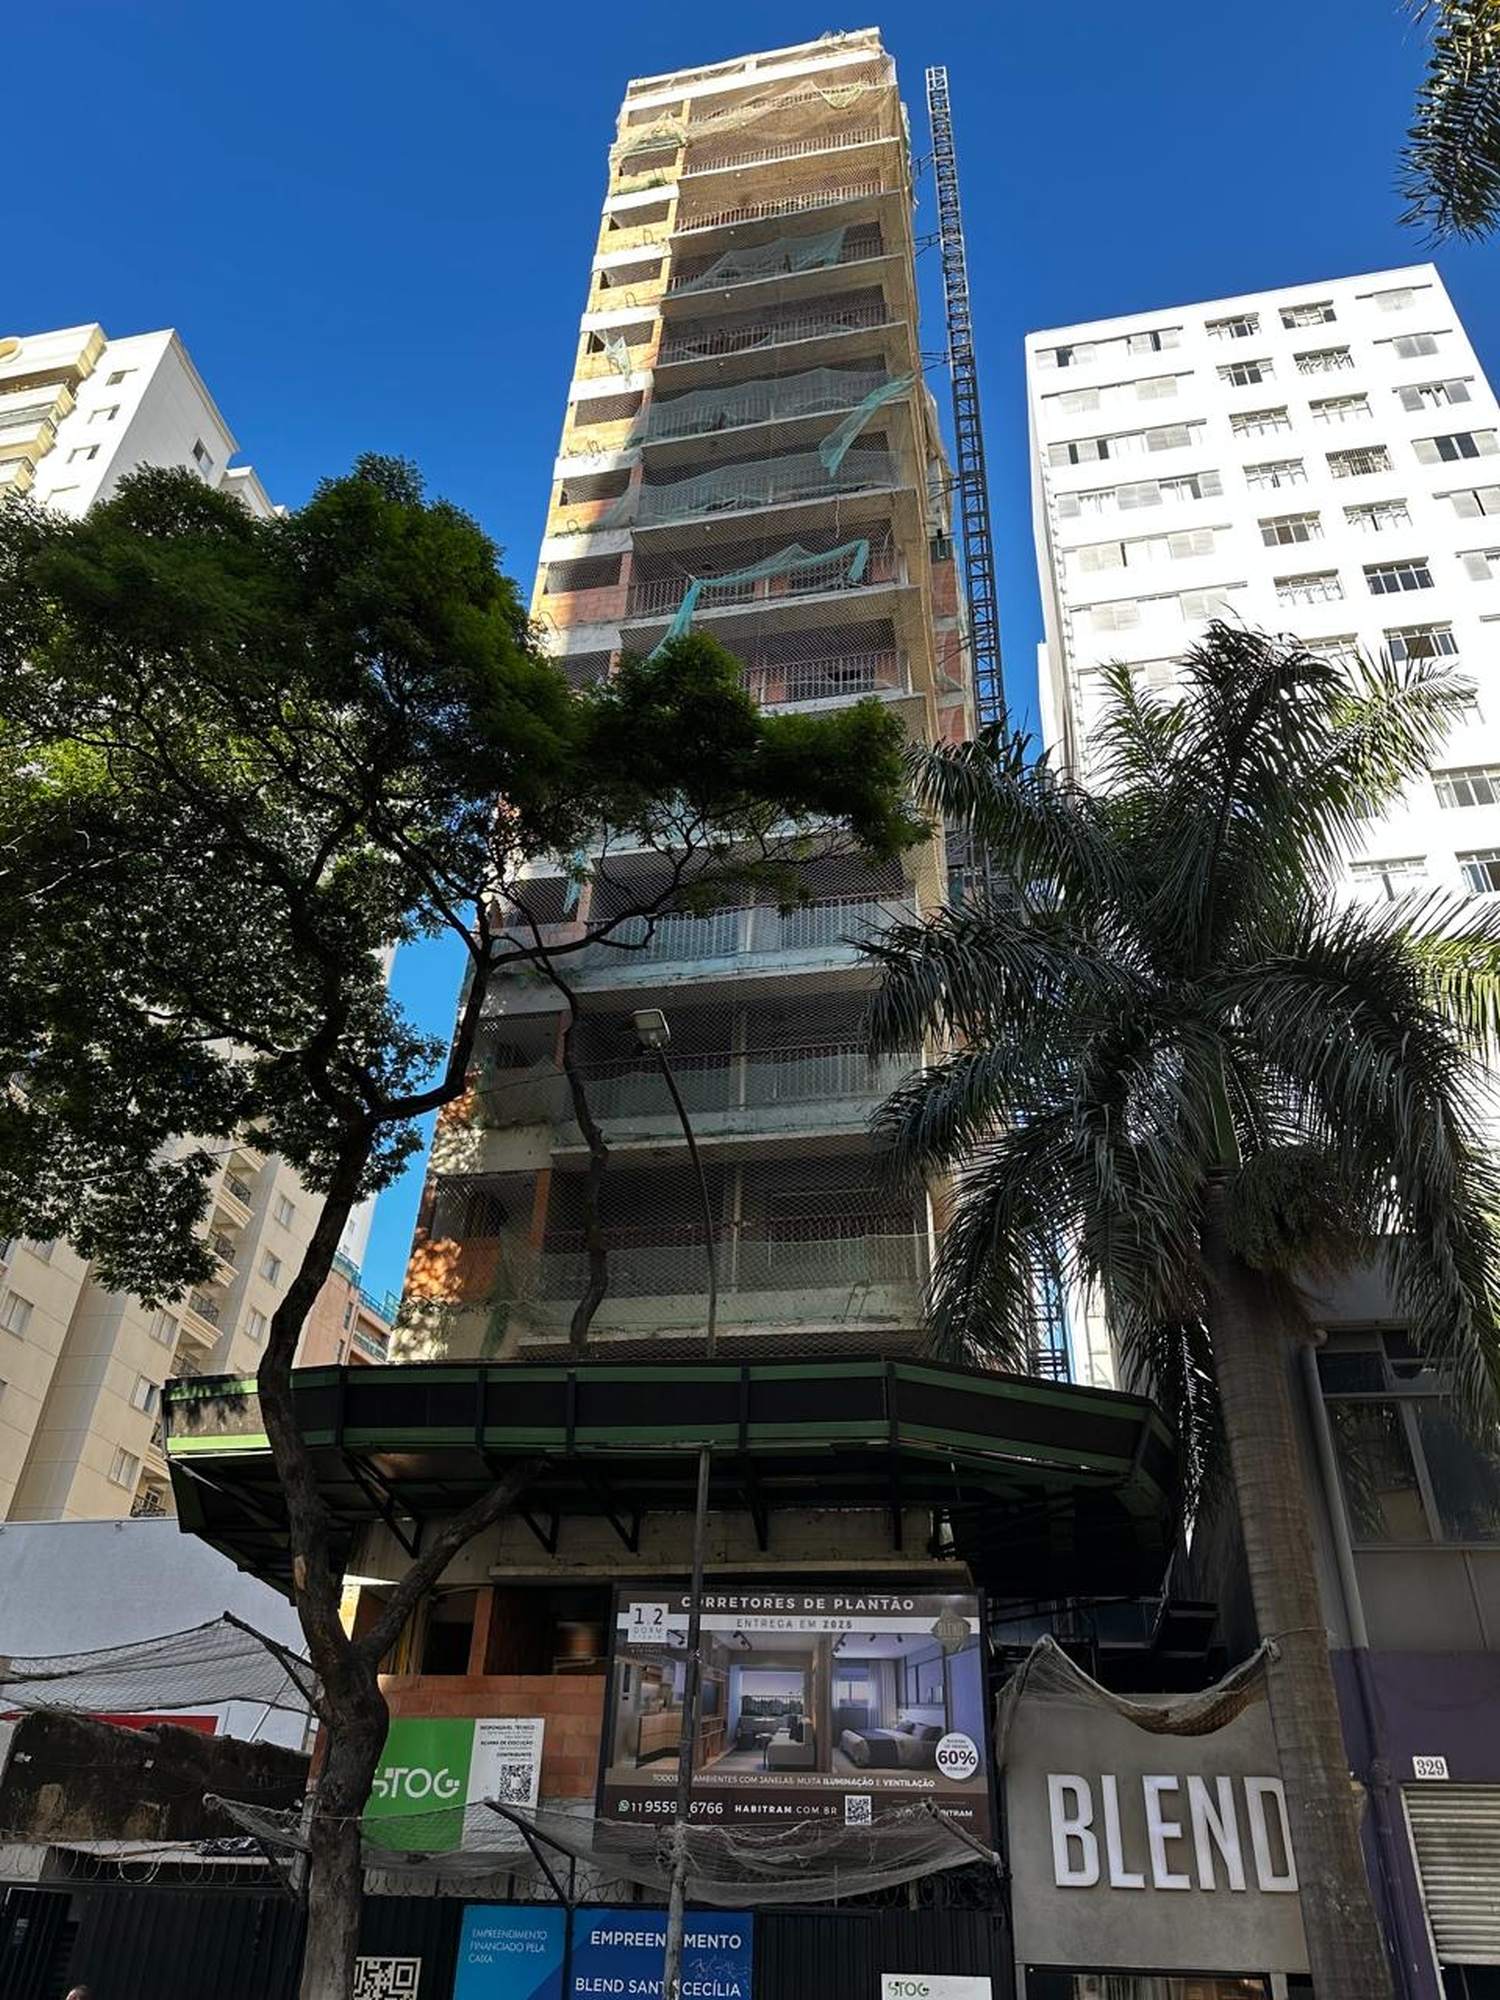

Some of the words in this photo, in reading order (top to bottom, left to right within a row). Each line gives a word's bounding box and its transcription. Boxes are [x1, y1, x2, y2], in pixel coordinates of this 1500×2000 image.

[681, 1596, 795, 1610] CRRETORES
[804, 1598, 826, 1609] DE
[833, 1596, 915, 1611] PLANTÃO
[736, 1618, 793, 1629] ENTREGA
[799, 1620, 817, 1629] EM
[823, 1620, 853, 1630] 2025
[937, 1750, 977, 1765] 60%
[1416, 1759, 1445, 1776] 329
[739, 1775, 758, 1784] COM
[883, 1778, 936, 1788] VENTILAÇÃO
[1047, 1774, 1299, 1892] BLEND
[591, 1931, 742, 1949] EMPREENMENTO
[526, 1943, 545, 1953] PELA
[575, 1978, 625, 1993] BLEND
[628, 1979, 672, 1994] SANT
[682, 1978, 741, 1997] CECÍLIA
